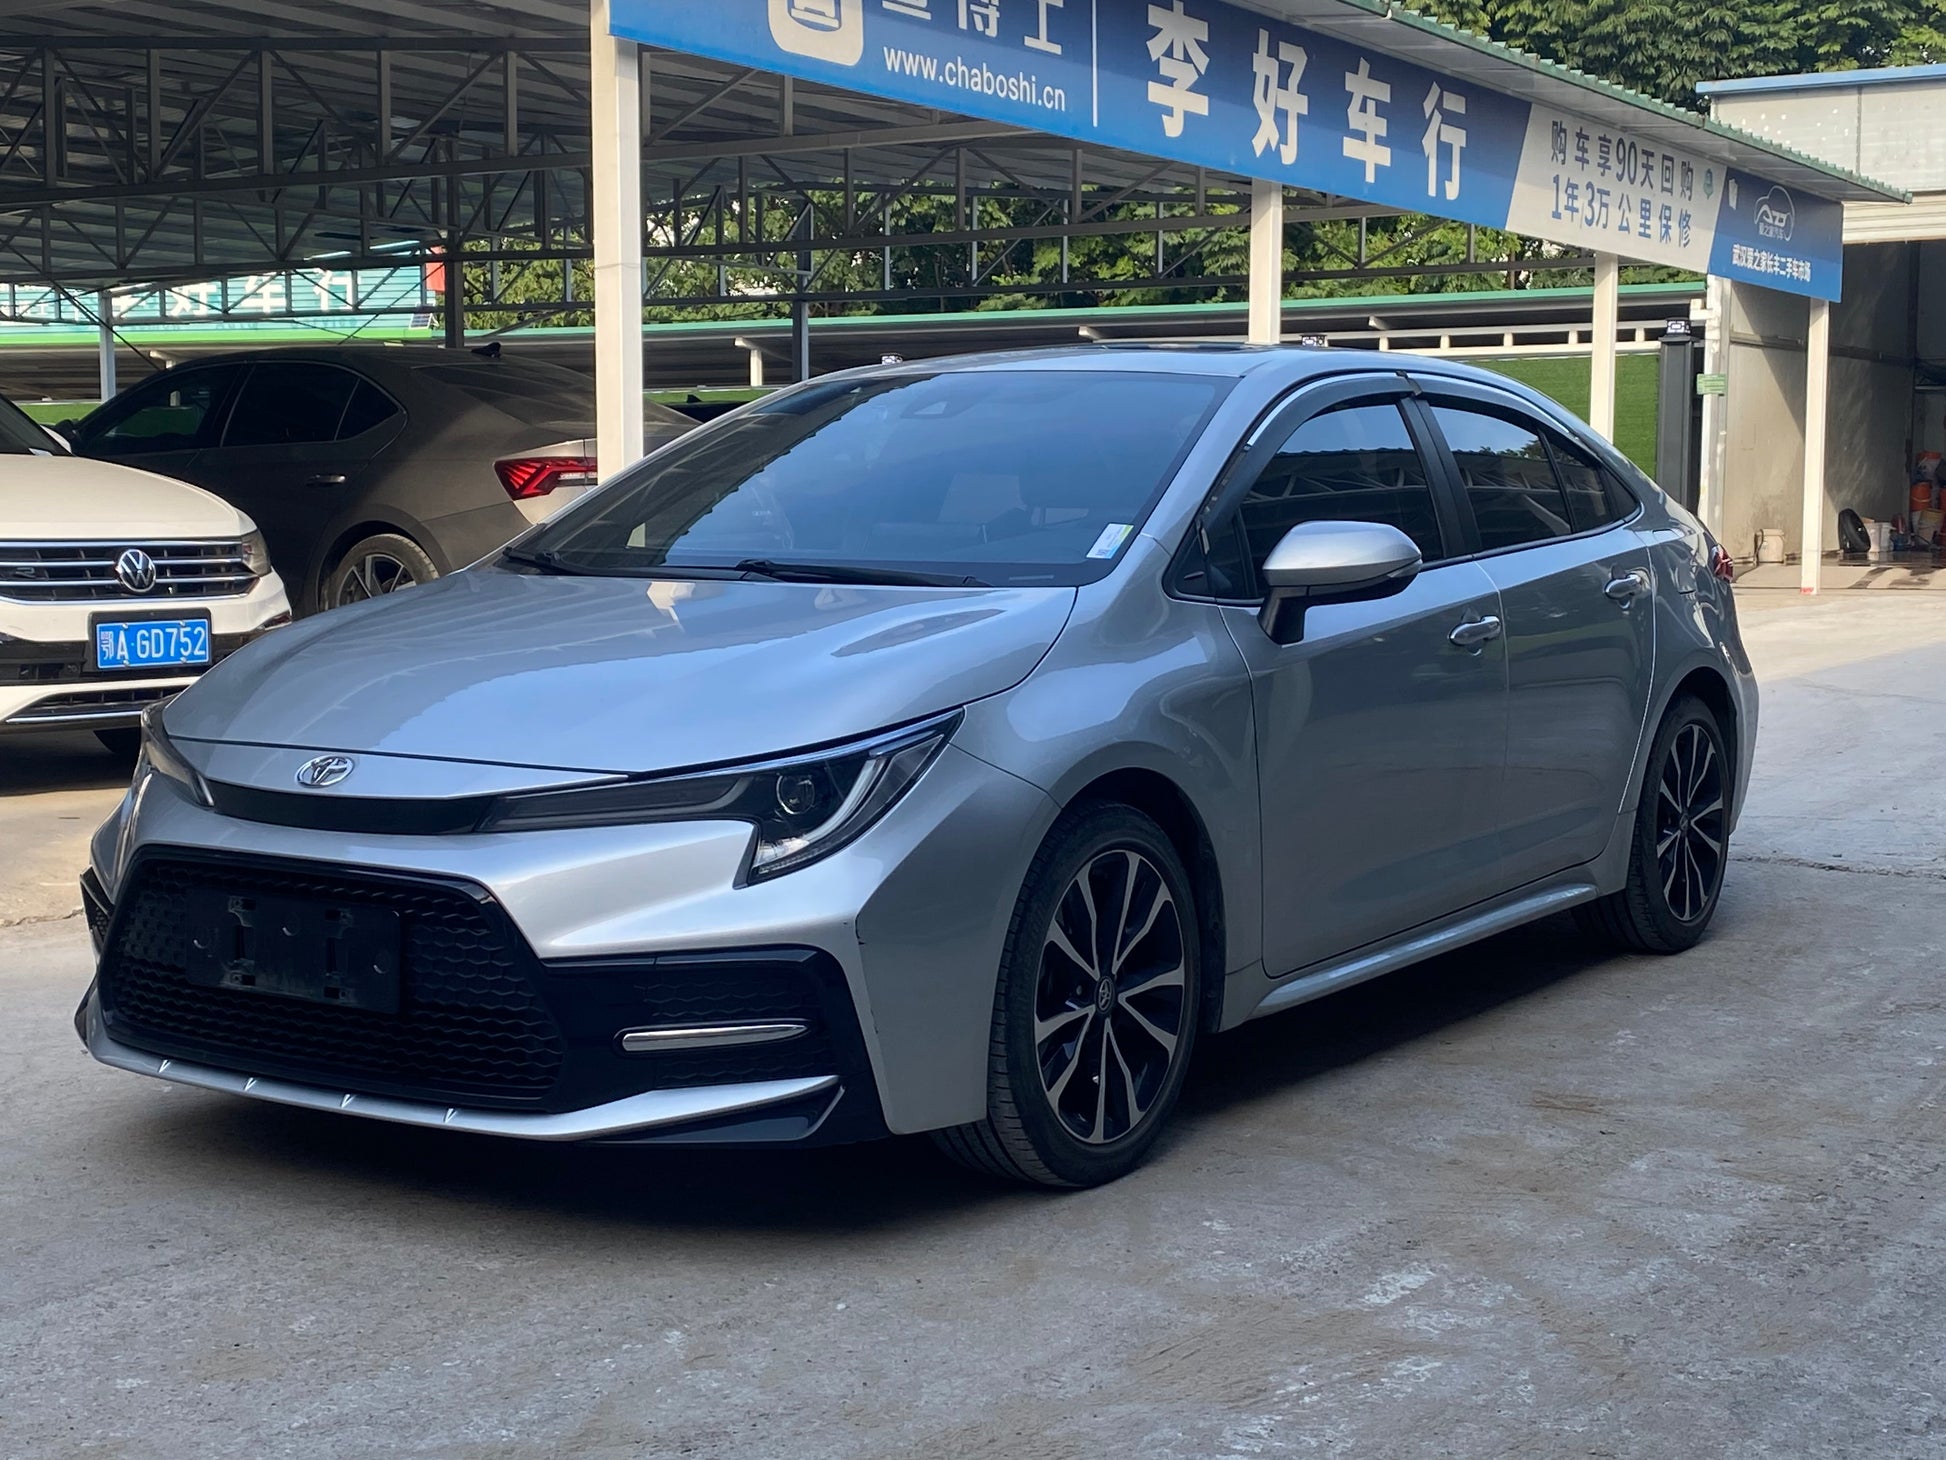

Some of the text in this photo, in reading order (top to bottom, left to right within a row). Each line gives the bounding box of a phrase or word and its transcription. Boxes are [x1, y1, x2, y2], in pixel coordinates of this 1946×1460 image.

[882, 46, 1066, 112] www.chaboshi.cn
[1146, 0, 1467, 201] 李好车行
[1551, 120, 1694, 202] 购车享90天回购
[1551, 173, 1692, 248] 1年3万公里保修
